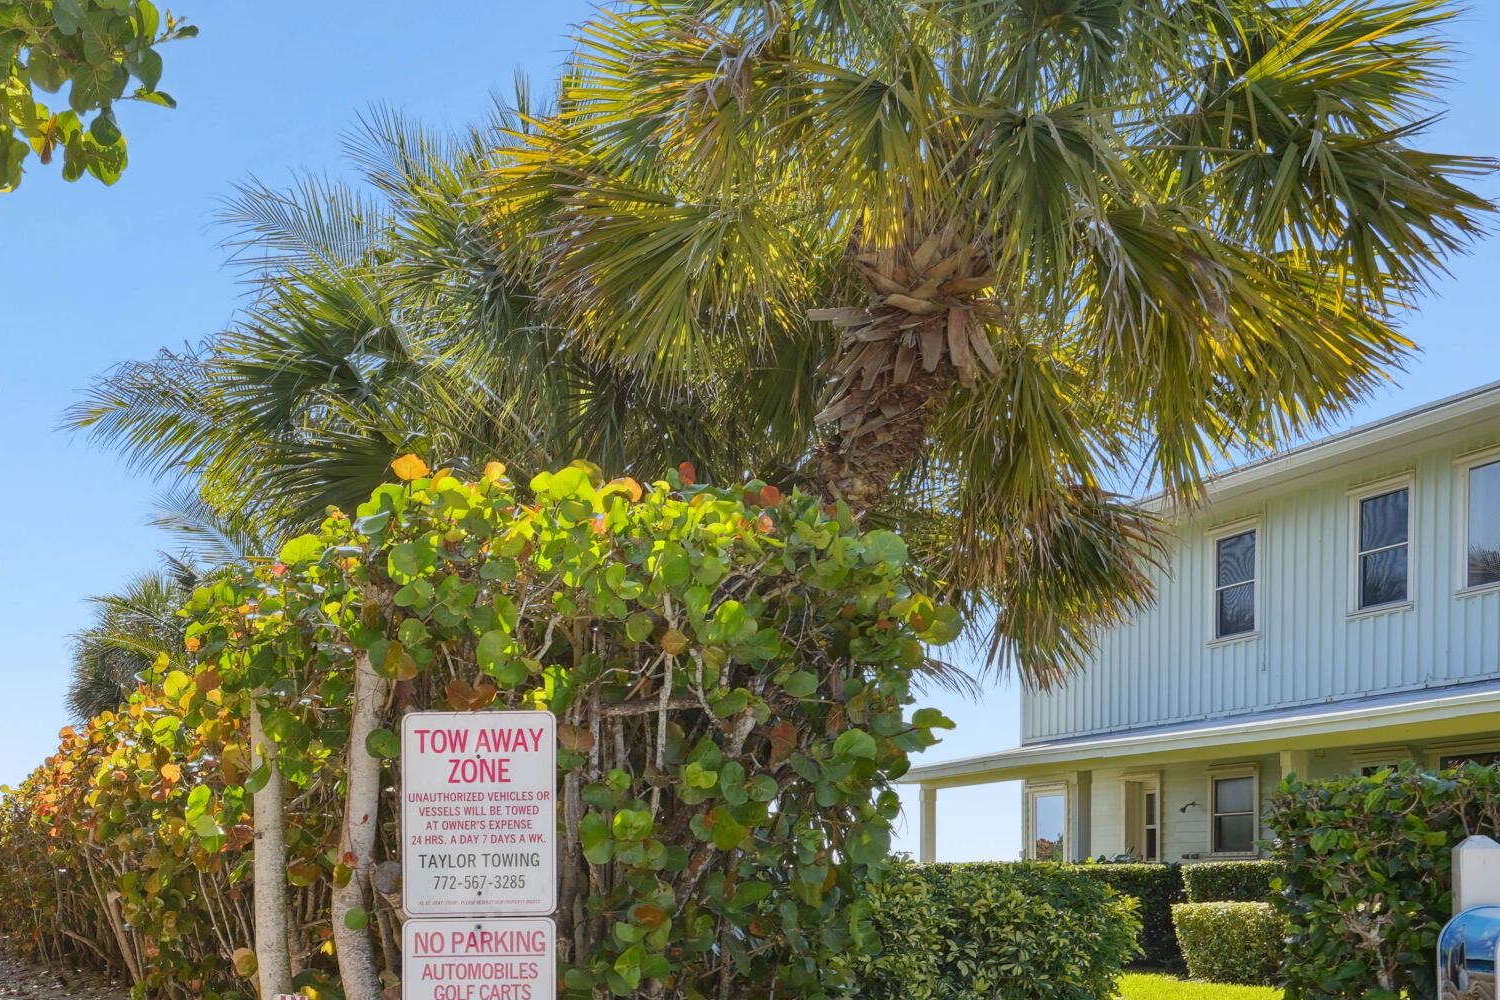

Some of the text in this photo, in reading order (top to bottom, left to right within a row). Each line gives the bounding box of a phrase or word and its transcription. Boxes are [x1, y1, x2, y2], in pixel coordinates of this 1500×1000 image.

[414, 728, 544, 753] TOW AWAY
[448, 758, 511, 783] ZONE
[408, 791, 550, 803] UNAUTHORIZED VEHICLES OR
[419, 805, 539, 817] VESSELS WILL BE TOWED
[426, 819, 532, 831] AT OWNER'S EXPENSE
[411, 833, 546, 845] 24 HRS. A DAY 7 DAYS A WK.
[418, 852, 540, 869] TAYLOR TOWING
[433, 874, 525, 890] 772-567-3285
[414, 930, 546, 953] NO PARKING
[421, 962, 538, 980] AUTOMOBILES
[434, 984, 531, 1000] GOLF CARTS
